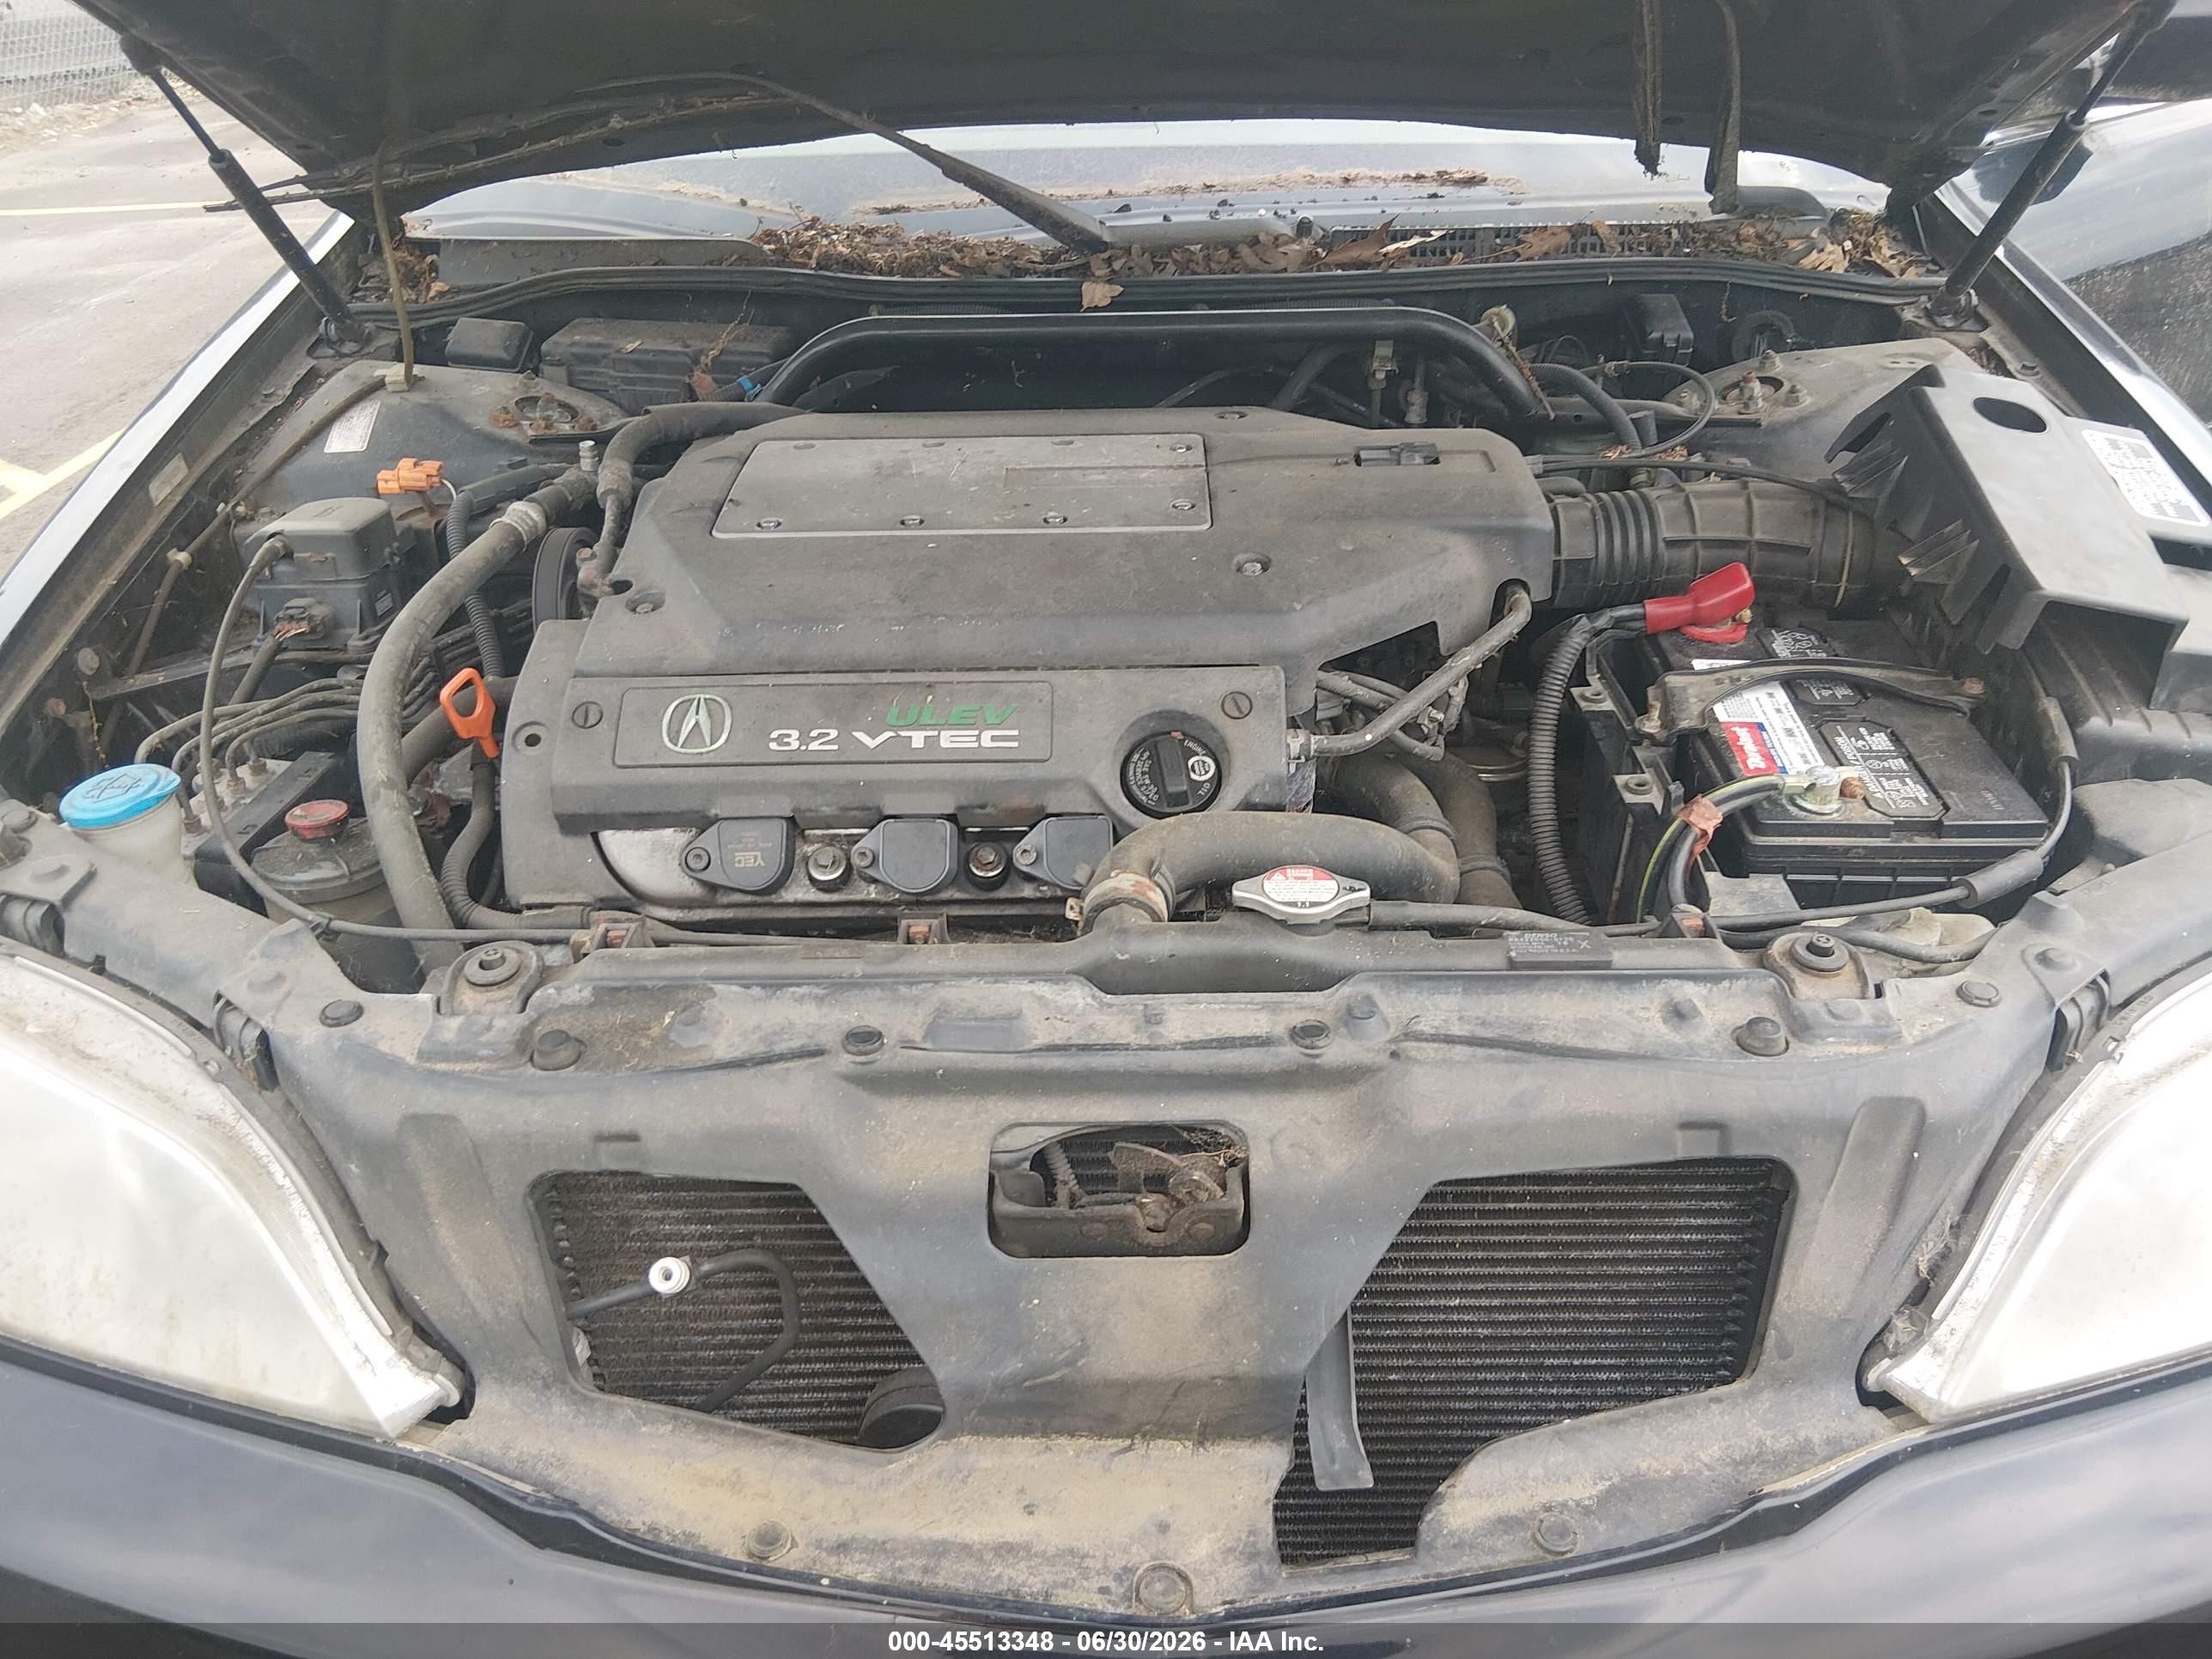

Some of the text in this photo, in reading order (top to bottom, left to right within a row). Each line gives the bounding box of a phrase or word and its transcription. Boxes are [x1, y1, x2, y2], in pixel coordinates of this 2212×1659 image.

[886, 703, 1018, 727] ULEV
[769, 729, 1019, 750] 3.2 VTEC
[1183, 739, 1206, 757] ENGINE
[1197, 782, 1211, 797] OIL
